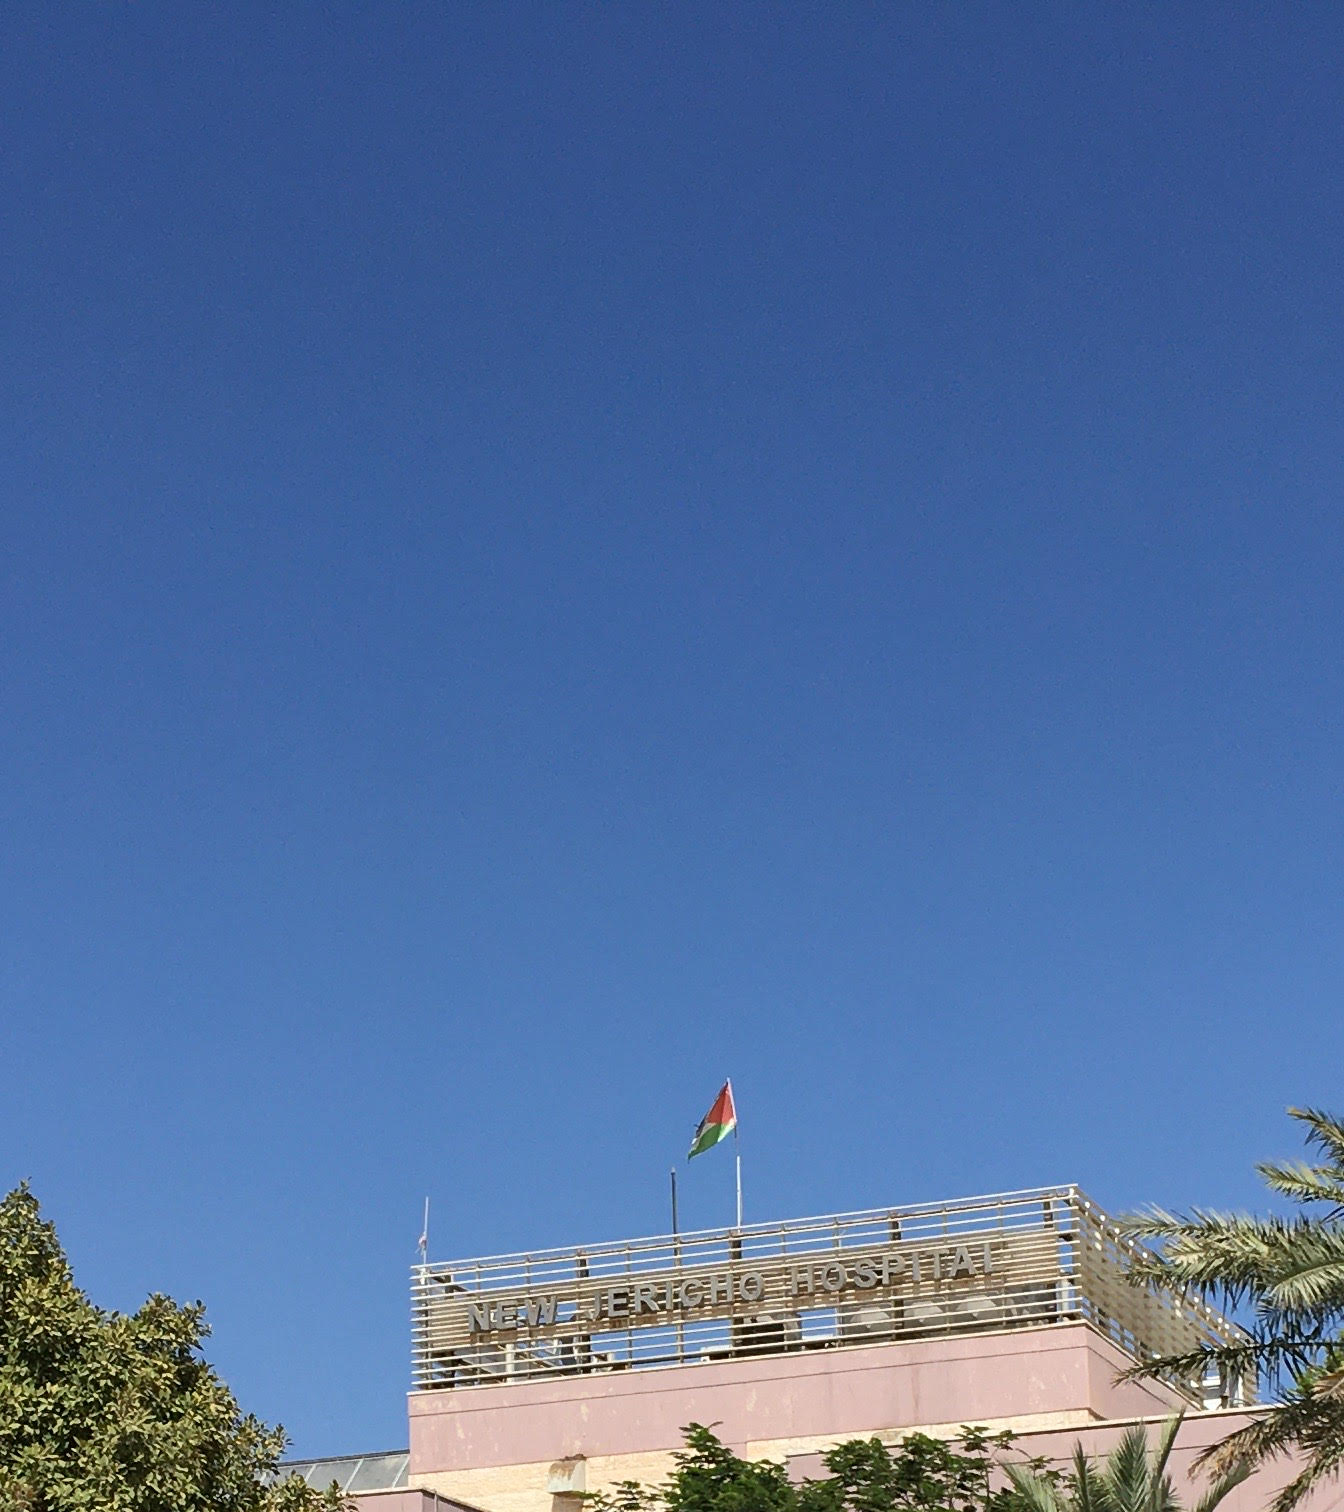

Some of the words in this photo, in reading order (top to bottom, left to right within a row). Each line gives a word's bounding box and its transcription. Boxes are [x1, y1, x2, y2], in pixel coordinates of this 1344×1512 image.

[467, 1296, 558, 1333] NEW
[586, 1271, 765, 1320] JERICHO
[791, 1244, 1000, 1295] HOSPITAL
